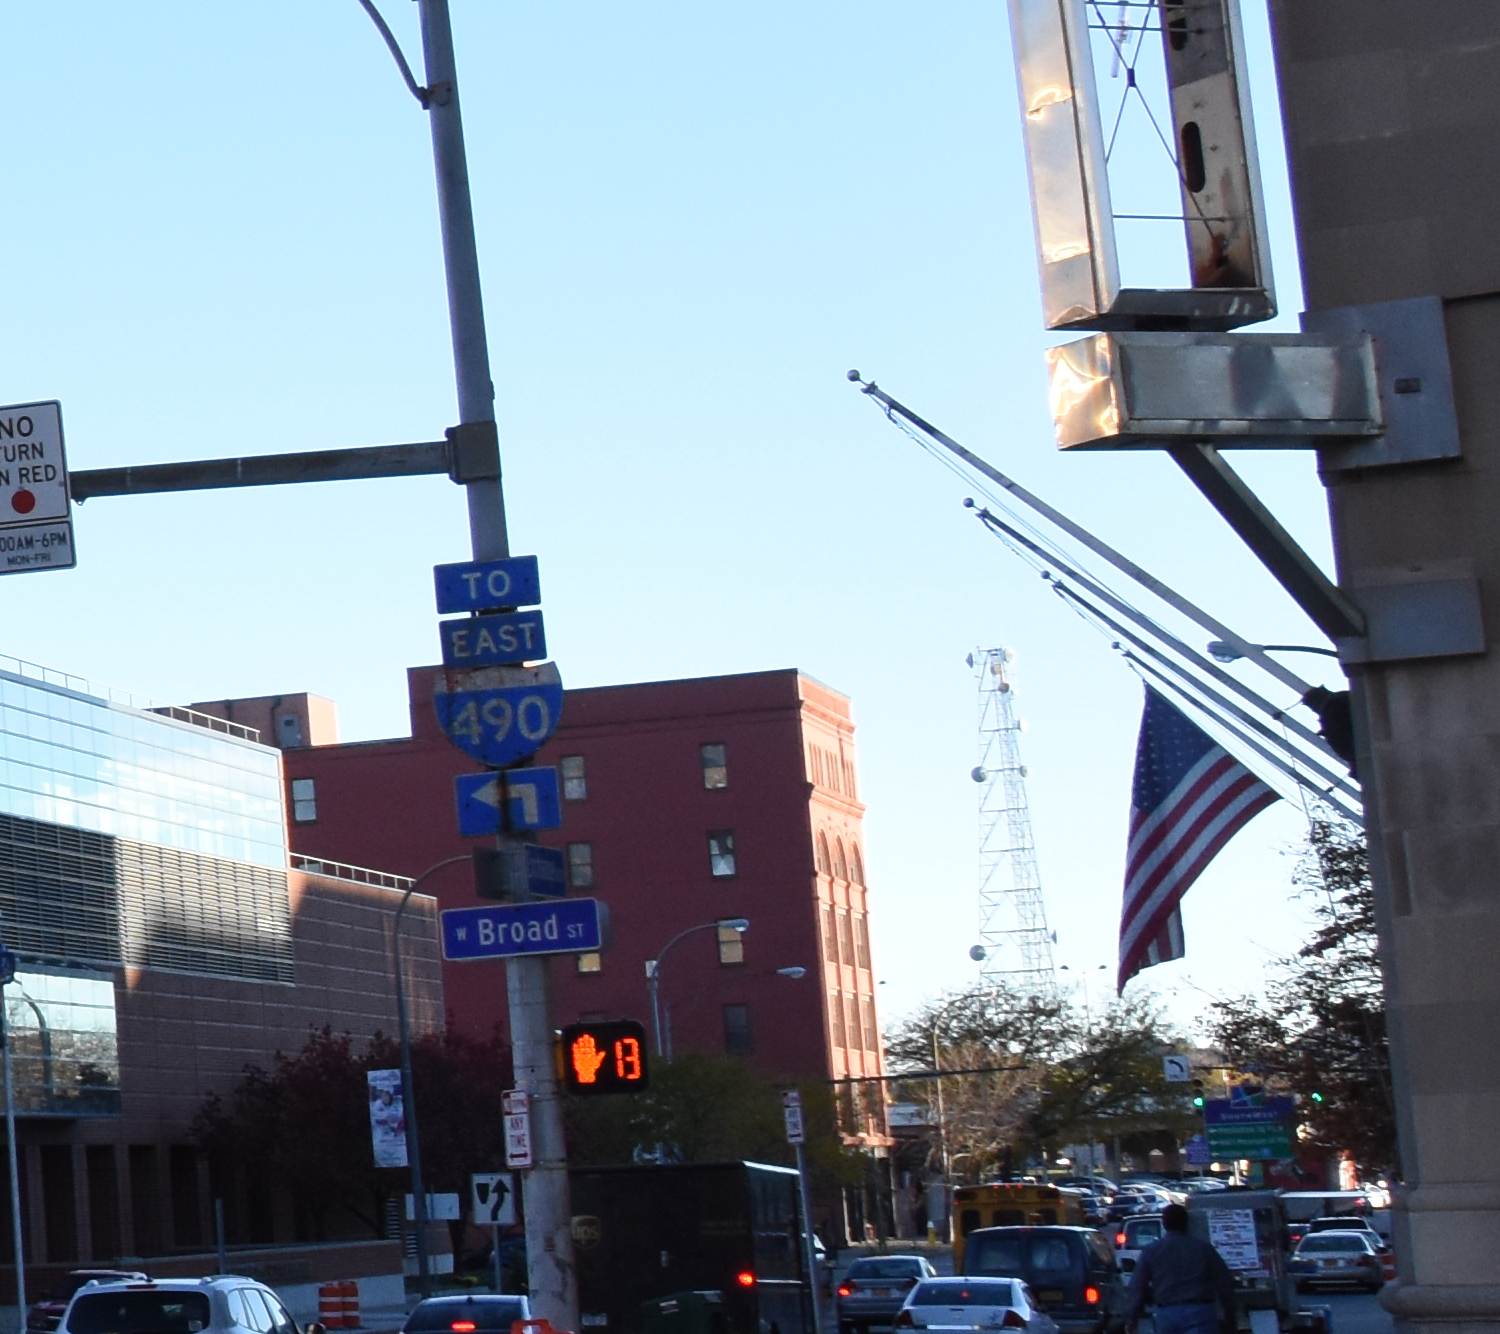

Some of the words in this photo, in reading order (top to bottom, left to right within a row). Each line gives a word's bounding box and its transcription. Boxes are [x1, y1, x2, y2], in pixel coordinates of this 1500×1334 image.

[18, 464, 57, 485] RED
[461, 569, 511, 600] TO
[452, 622, 536, 658] EAST
[453, 695, 551, 746] 490
[456, 927, 467, 941] W
[477, 913, 559, 946] Broad
[566, 923, 585, 939] ST
[615, 1038, 642, 1080] 13
